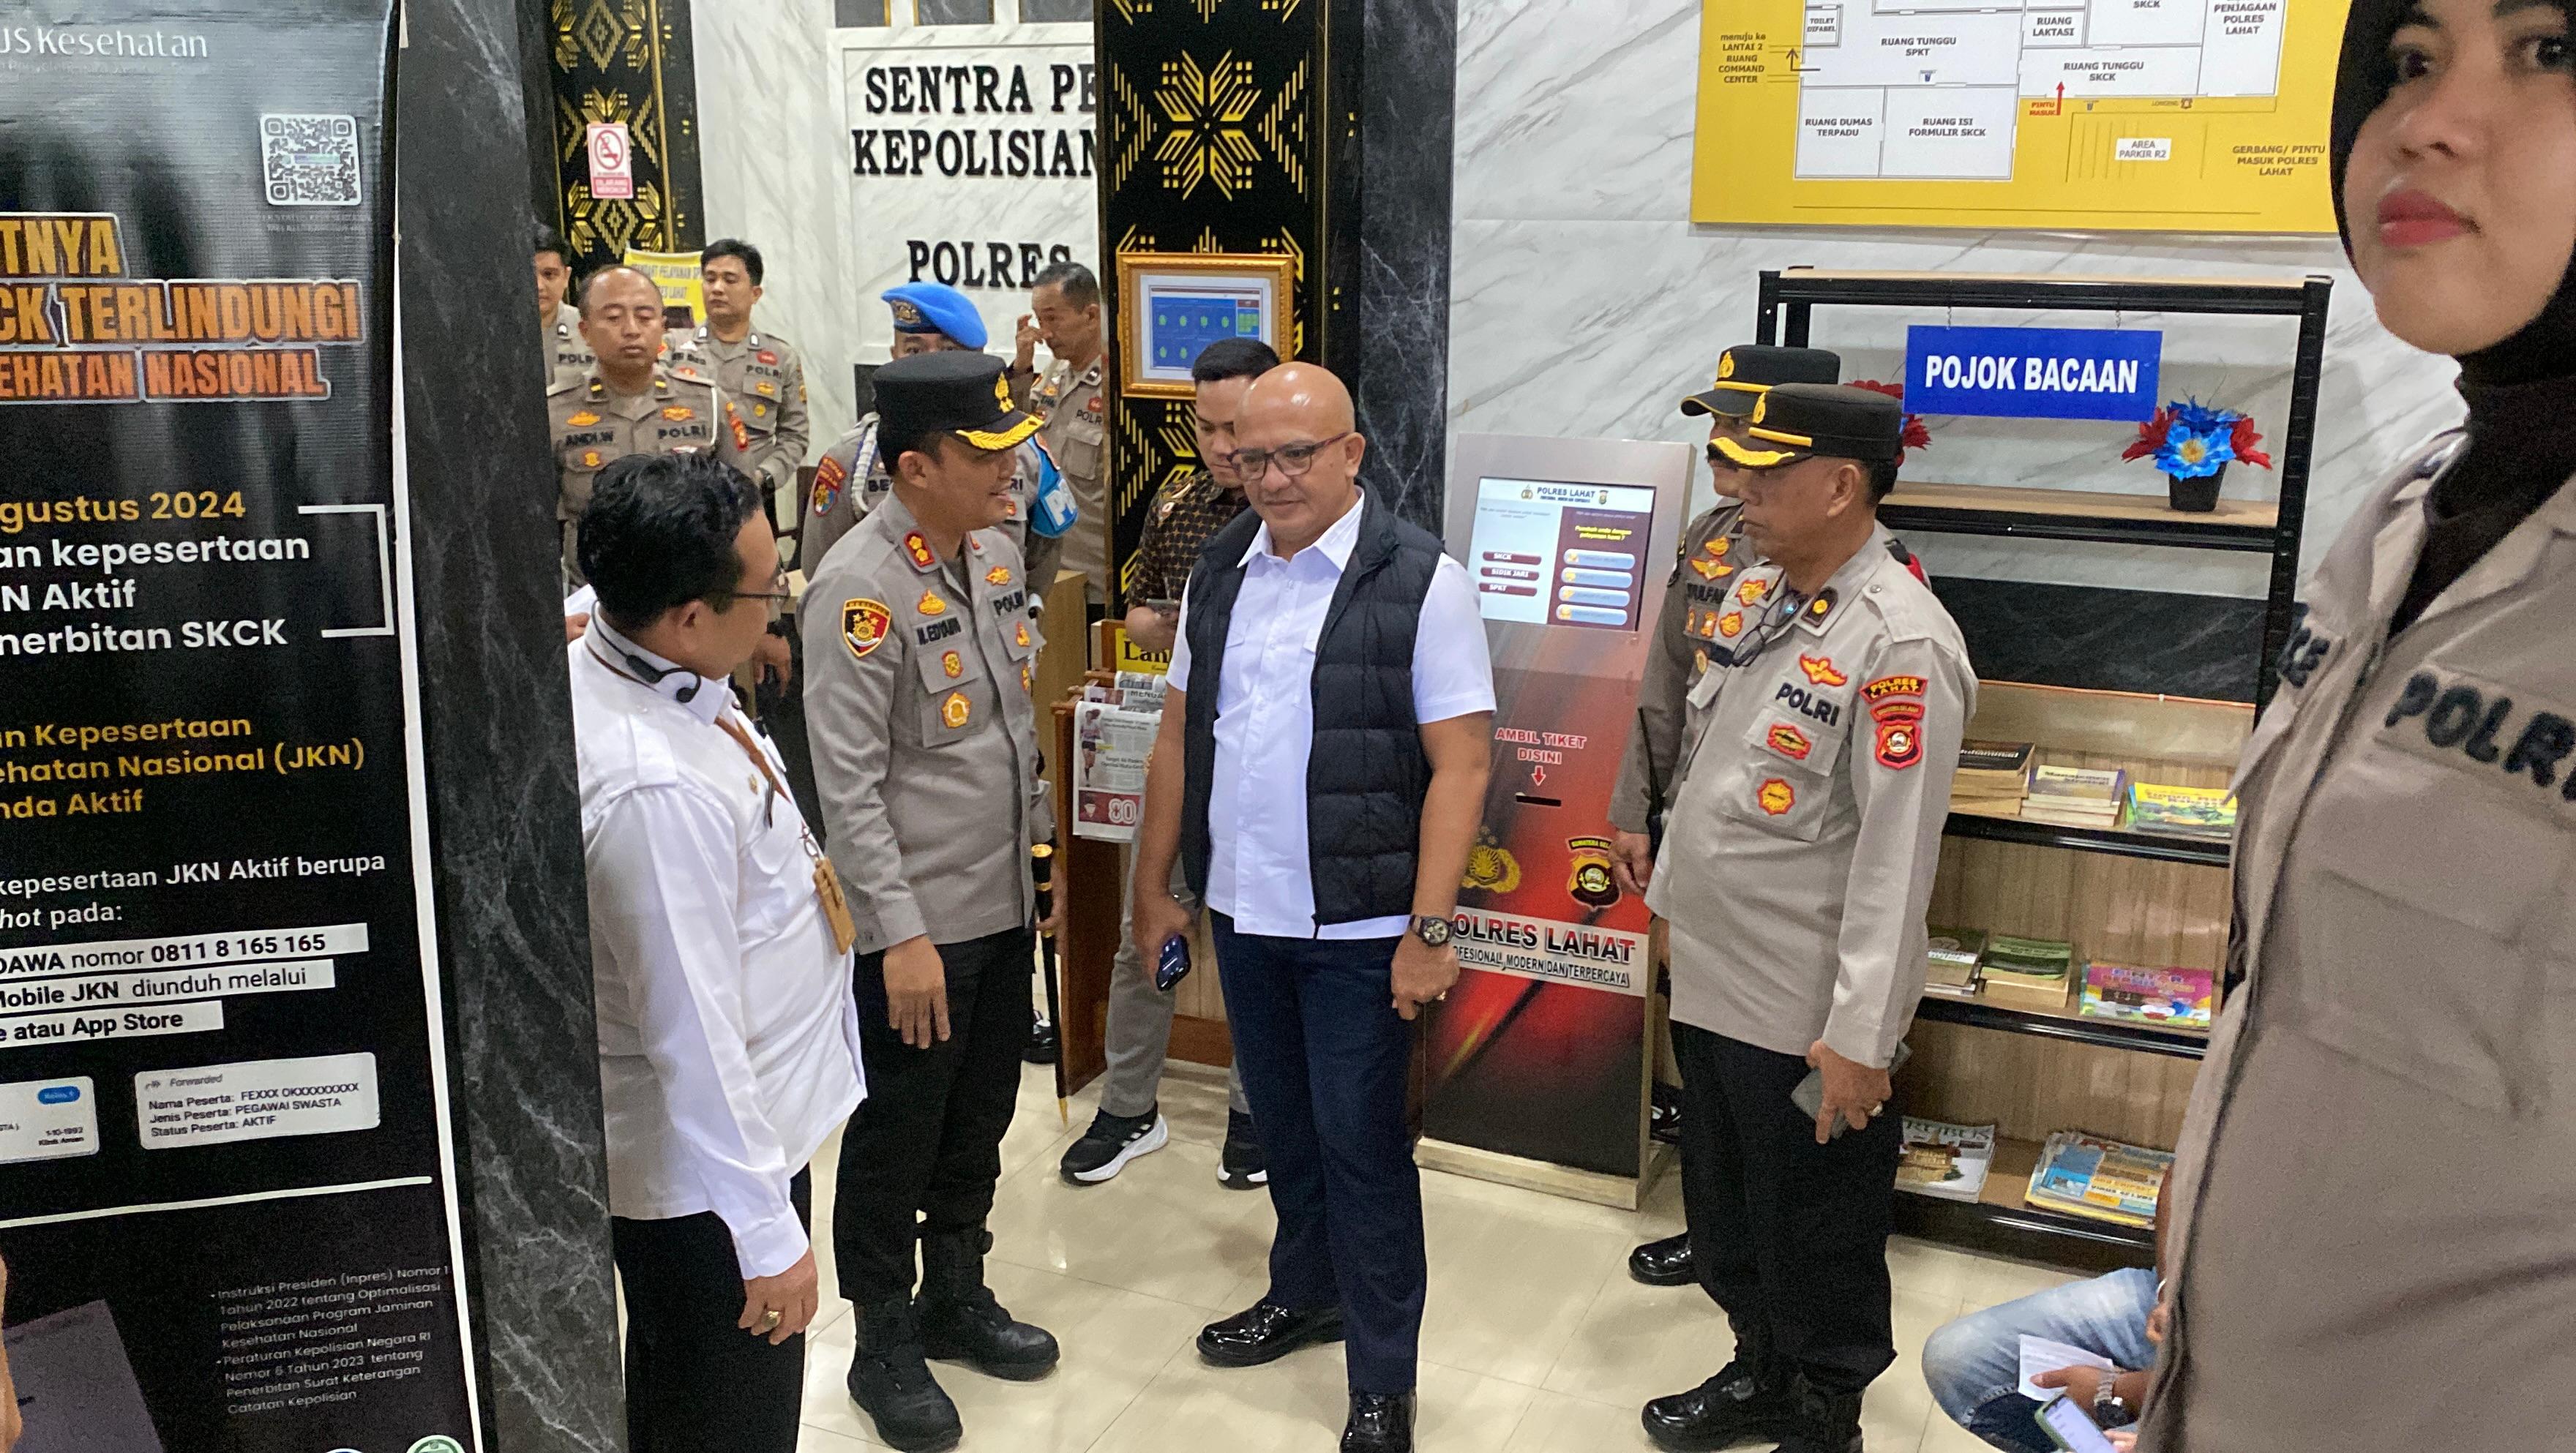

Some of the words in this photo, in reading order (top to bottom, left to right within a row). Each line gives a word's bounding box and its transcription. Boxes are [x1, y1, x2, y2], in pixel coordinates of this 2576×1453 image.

[2214, 3, 2277, 12] PENJAGAAN
[2223, 15, 2265, 23] POLRES
[2032, 28, 2075, 37] LAKTASI
[2037, 17, 2073, 26] RUANG
[2225, 26, 2260, 34] LAHAT
[0, 28, 32, 54] JS
[37, 28, 208, 57] Kesehatan
[1881, 38, 1914, 46] RUANG
[1917, 37, 1957, 45] TUNGGU
[1906, 48, 1931, 56] SPKT
[1718, 65, 1765, 73] COMMAND
[2064, 62, 2099, 71] RUANG
[2102, 61, 2144, 70] TUNGGU
[2089, 73, 2116, 81] SKCK
[865, 64, 1033, 113] SENTRA
[1723, 75, 1758, 83] CENTER
[1805, 118, 1838, 126] RUANG
[1840, 118, 1873, 126] DUMAS
[1817, 129, 1860, 137] TERPADU
[1909, 129, 1958, 137] FORMULIR
[1961, 129, 1986, 137] SKCK
[1922, 118, 1955, 126] RUANG
[1958, 118, 1973, 126] ISI
[852, 129, 1098, 176] KEPOLISIAN
[2119, 149, 2152, 158] PARKIR
[2154, 150, 2167, 158] R2
[2131, 140, 2155, 149] AREA
[2292, 146, 2326, 154] PINTU
[2237, 157, 2274, 165] MASUK
[2277, 157, 2318, 165] POLRES
[2259, 168, 2293, 176] LAHAT
[0, 219, 121, 274] TNYA
[0, 286, 50, 341] CK
[61, 282, 361, 342] TERLINDUNGI
[0, 354, 135, 397] EHATAN
[147, 350, 324, 397] NASIONAL
[1925, 355, 2018, 391] POJOK
[2024, 358, 2138, 394] BACAAN
[1076, 409, 1103, 425] POLR
[1538, 487, 1568, 496] POLRES
[1570, 489, 1596, 498] LAHAT
[0, 495, 140, 533] gustus
[151, 491, 246, 519] 2024
[52, 536, 310, 574] kepesertaan
[42, 579, 137, 611] Aktif
[0, 622, 171, 656] nerbitan
[182, 618, 288, 647] SKCK
[1775, 681, 1841, 727] POLRI
[35, 717, 252, 751] Kepesertaan
[1496, 728, 1540, 744] AMBIL
[1543, 732, 1587, 749] TIKET
[119, 748, 265, 778] Nasional
[274, 738, 364, 776] (JKN)
[1517, 748, 1562, 765] DISINI
[0, 795, 57, 819] nda
[67, 789, 143, 816] Aktif
[165, 862, 220, 885] JKN
[229, 857, 290, 880] Aktif
[297, 855, 386, 881] berupa
[50, 902, 123, 930] pada:
[1454, 913, 1538, 949] OLRES
[1546, 927, 1636, 964] LAHAT
[72, 949, 144, 969] nomor
[151, 942, 206, 963] 0811
[216, 939, 229, 958] 8
[237, 936, 277, 955] 165
[285, 934, 326, 953] 165
[1506, 953, 1545, 973] MODERN
[1547, 961, 1566, 975] DAN
[70, 981, 119, 1002] JKN
[132, 972, 220, 998] diunduh
[228, 967, 307, 989] melalui
[14, 1021, 65, 1041] atau
[72, 1015, 117, 1037] App
[124, 1011, 184, 1031] Store
[149, 1100, 184, 1111] Nama
[187, 1094, 234, 1107] Peserta:
[150, 1114, 181, 1124] Jenis
[184, 1108, 232, 1120] Peserta:
[236, 1102, 290, 1114] PEGAWAI
[293, 1097, 342, 1110] SWASTA
[151, 1126, 188, 1138] Status
[191, 1121, 239, 1133] Peserta:
[242, 1115, 277, 1127] AKTIF
[218, 1284, 275, 1299] Instruksi
[279, 1277, 337, 1293] Presiden
[397, 1266, 440, 1279] Nomor
[266, 1297, 299, 1310] 2022
[302, 1291, 355, 1307] tentang
[359, 1283, 441, 1300] Optimalisasi
[221, 1313, 310, 1332] Pelaksanaan
[313, 1306, 371, 1322] Program
[375, 1299, 434, 1314] Jaminan
[222, 1332, 296, 1348] Kesehatan
[299, 1323, 358, 1338] Nasional
[223, 1351, 292, 1365] Peraturan
[295, 1340, 364, 1358] Kepolisian
[367, 1333, 416, 1349] Negara
[225, 1369, 271, 1382] Nomor
[287, 1362, 329, 1375] Tahun
[332, 1355, 364, 1369] 2023
[371, 1349, 423, 1364] tentang
[226, 1381, 300, 1398] Penerbitan
[304, 1375, 339, 1389] Surat
[342, 1365, 421, 1383] Keterangan
[228, 1399, 285, 1414] Catatan
[288, 1390, 357, 1407] Kepolisian
